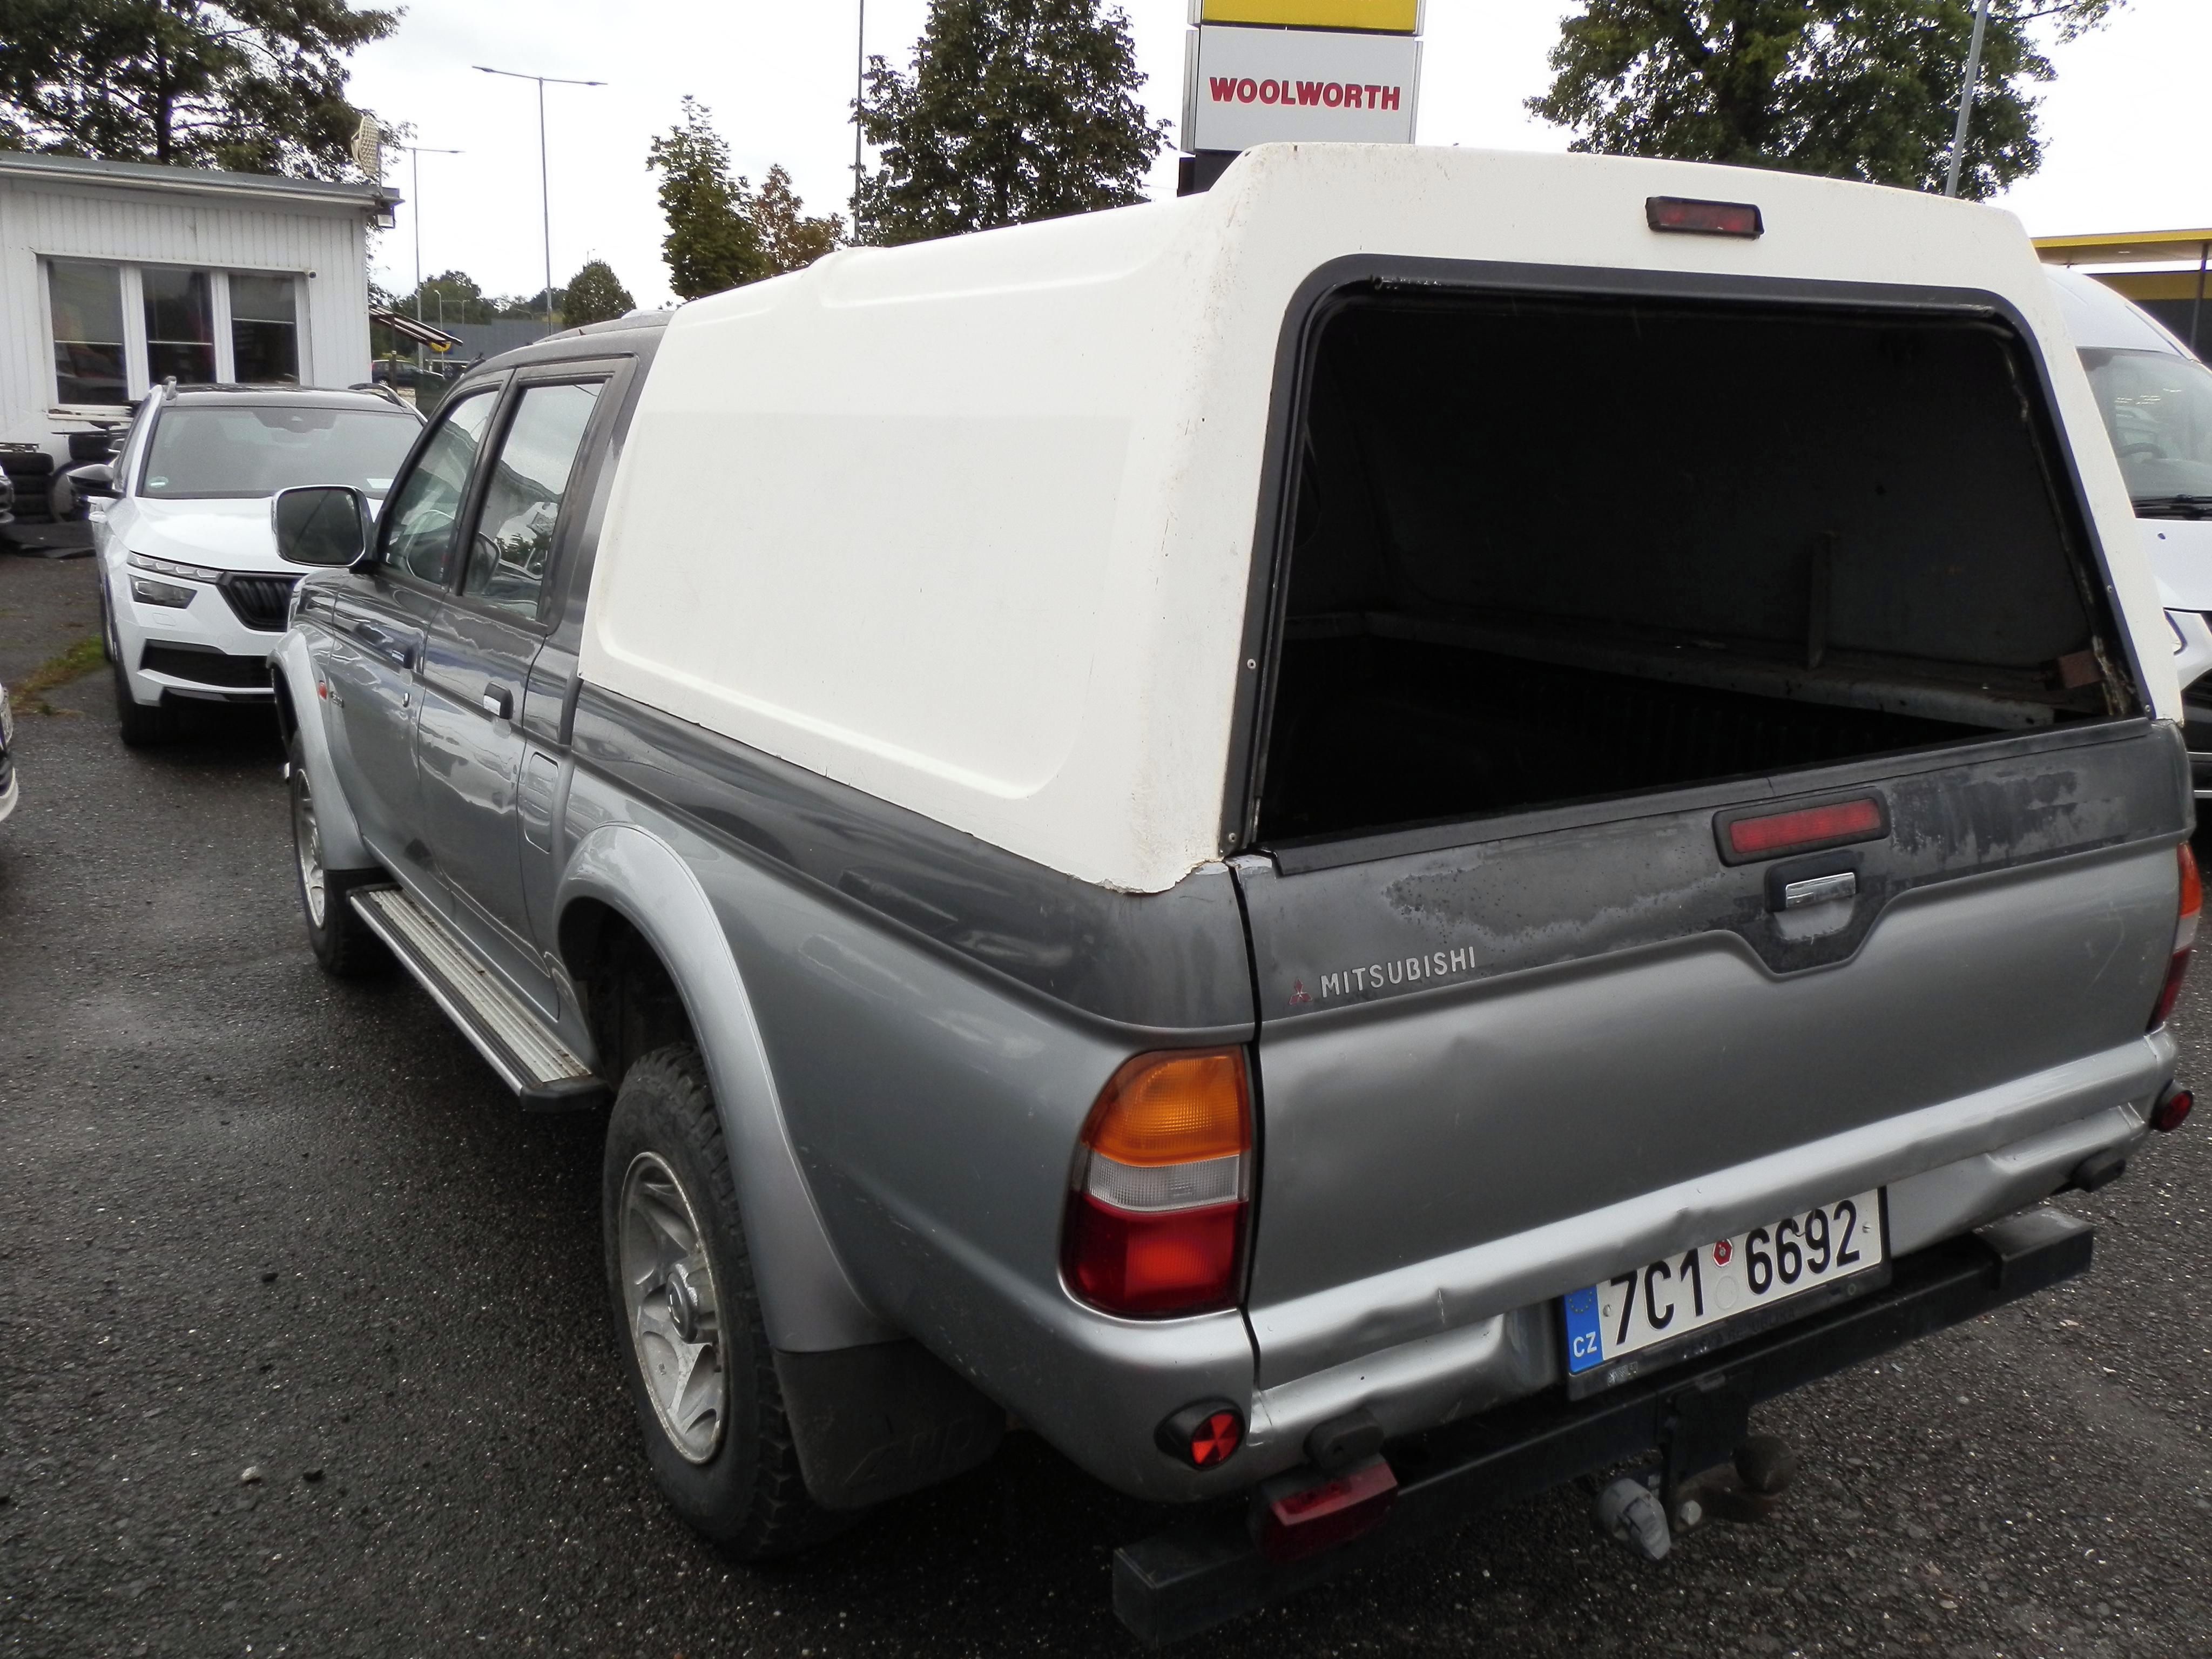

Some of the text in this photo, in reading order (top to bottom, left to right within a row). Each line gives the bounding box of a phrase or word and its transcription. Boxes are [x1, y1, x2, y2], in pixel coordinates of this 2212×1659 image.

[1209, 77, 1400, 110] WOOLWORTH
[1320, 946, 1475, 998] MITSUBISHI
[1610, 1199, 1860, 1346] 7C1 6692
[1573, 1331, 1597, 1358] CZ
